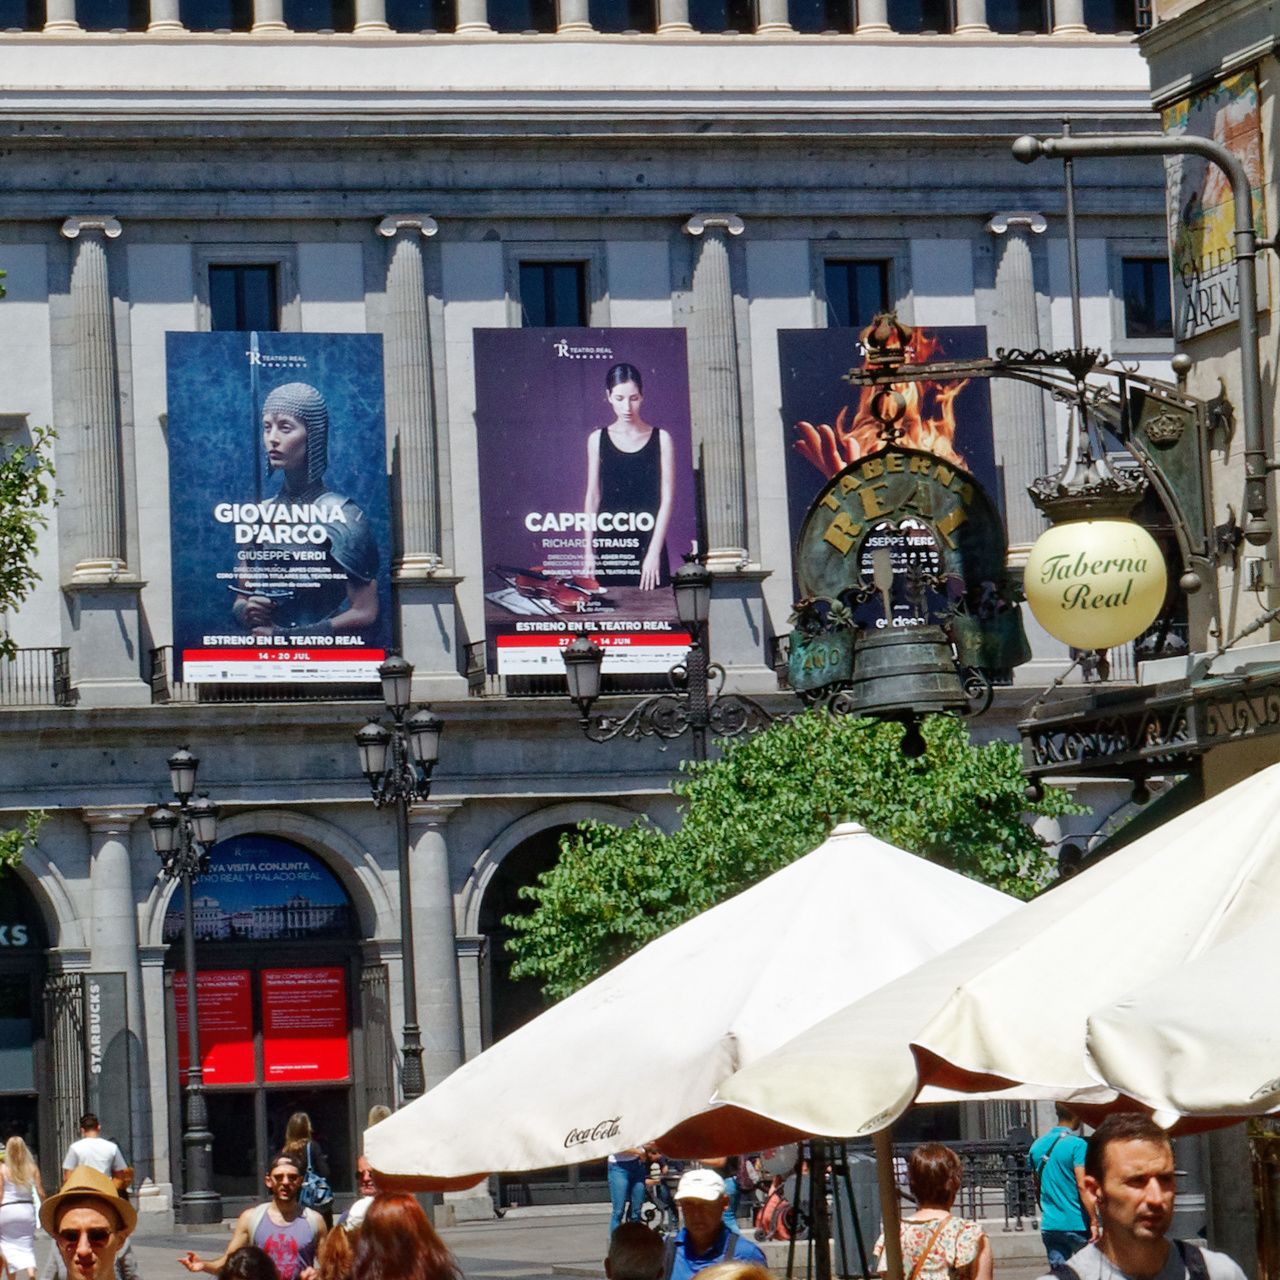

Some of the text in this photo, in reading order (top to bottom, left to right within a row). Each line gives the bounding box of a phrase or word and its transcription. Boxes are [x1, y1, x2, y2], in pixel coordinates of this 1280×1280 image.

[1179, 246, 1228, 289] CALLE
[214, 503, 347, 523] GIOVANNA
[823, 480, 968, 556] REAL
[524, 512, 655, 532] CAPRICCIO
[234, 524, 328, 544] D'ARCO
[906, 536, 936, 546] VERD
[542, 538, 640, 548] RICHARD STRAUSS
[237, 550, 327, 561] GIUSEPPE VERDI
[1040, 551, 1148, 585] Taberna
[1061, 578, 1134, 611] Real
[516, 621, 672, 631] ESTRENO EN EL TEATRO REAL
[203, 635, 365, 646] ESTRENO EN EL TEATRO REAL
[558, 638, 569, 646] 27
[600, 638, 611, 646] 14
[258, 652, 269, 660] 14
[277, 652, 290, 660] 20
[293, 652, 311, 660] JUL
[226, 862, 258, 872] VISITA
[258, 862, 310, 871] CONJUNTA
[220, 873, 245, 883] REAL
[255, 872, 297, 882] PALACIO
[297, 871, 323, 881] REAL
[90, 983, 102, 1074] STARBUCKS
[564, 1116, 622, 1149] Coca-Cola
